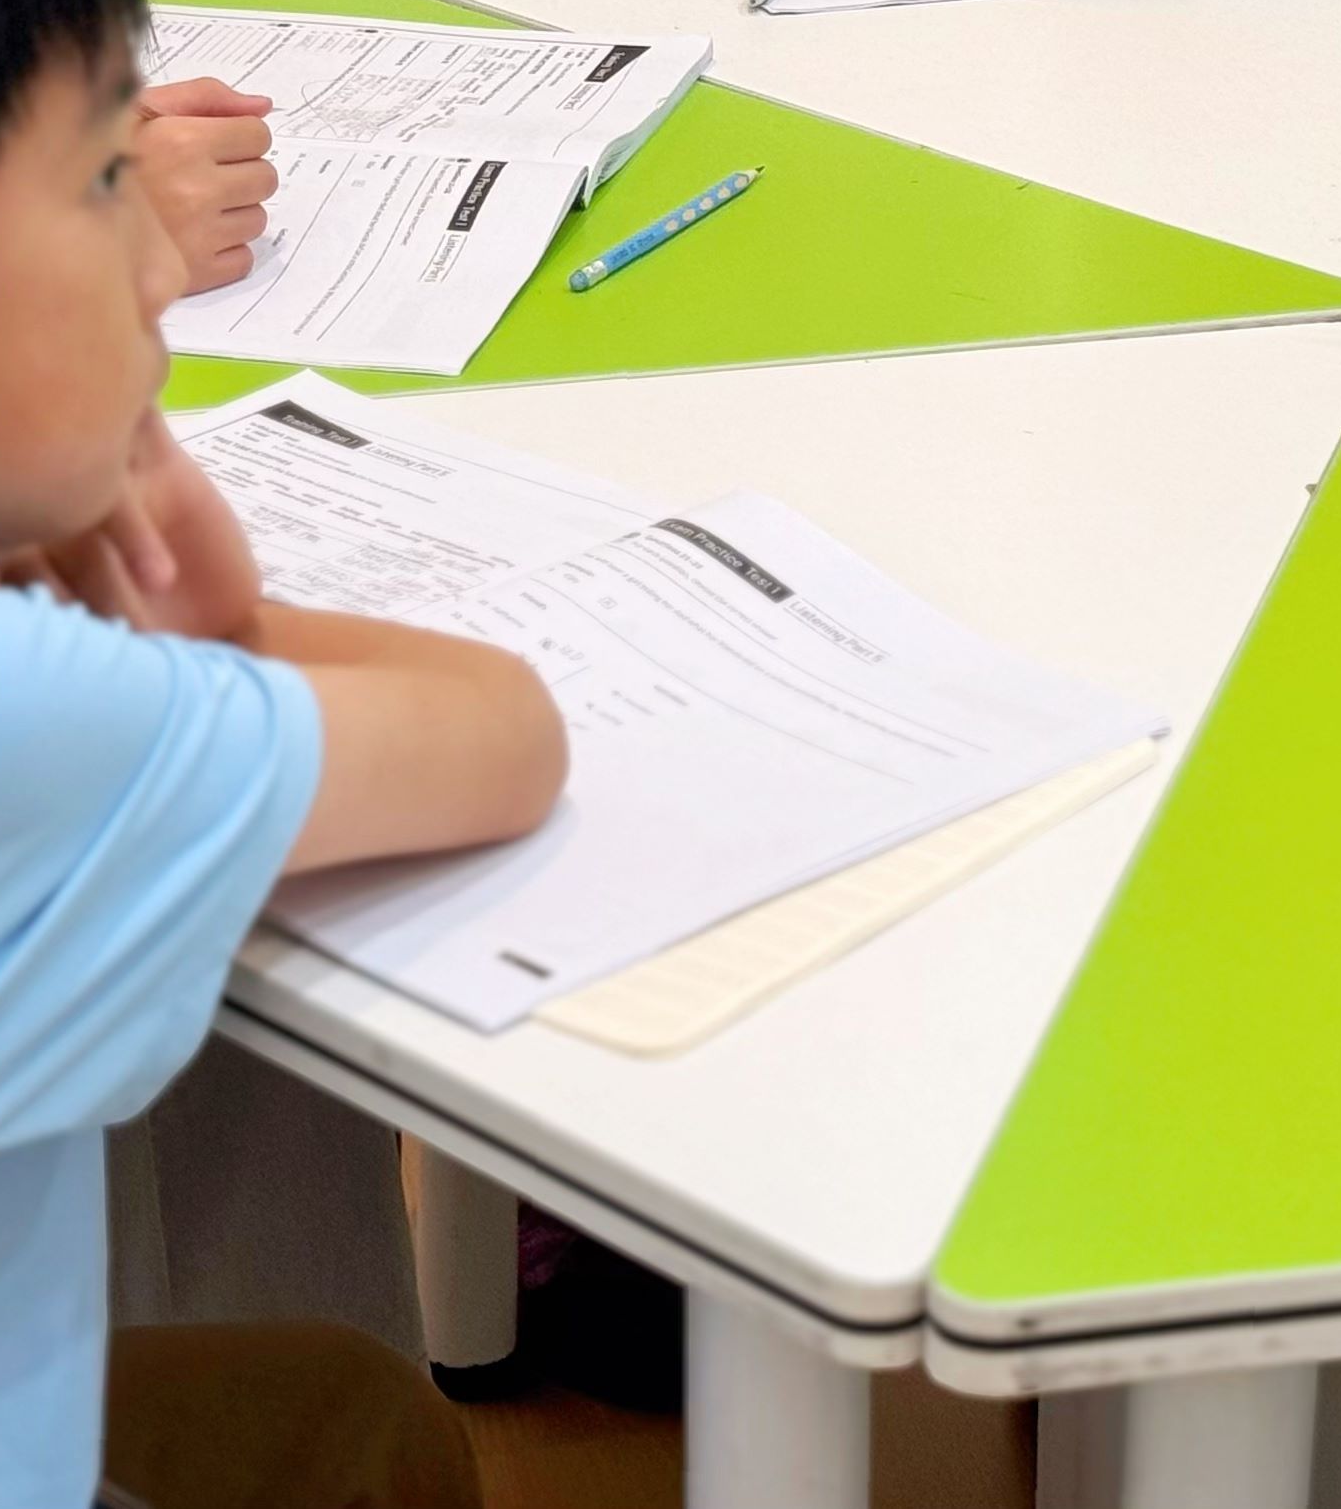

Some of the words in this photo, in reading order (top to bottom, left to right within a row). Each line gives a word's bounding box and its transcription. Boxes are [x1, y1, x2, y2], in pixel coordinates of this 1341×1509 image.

[325, 427, 349, 445] Test
[694, 528, 745, 570] Practice
[744, 565, 774, 593] Test
[788, 599, 848, 646] Listening
[844, 631, 873, 659] Part
